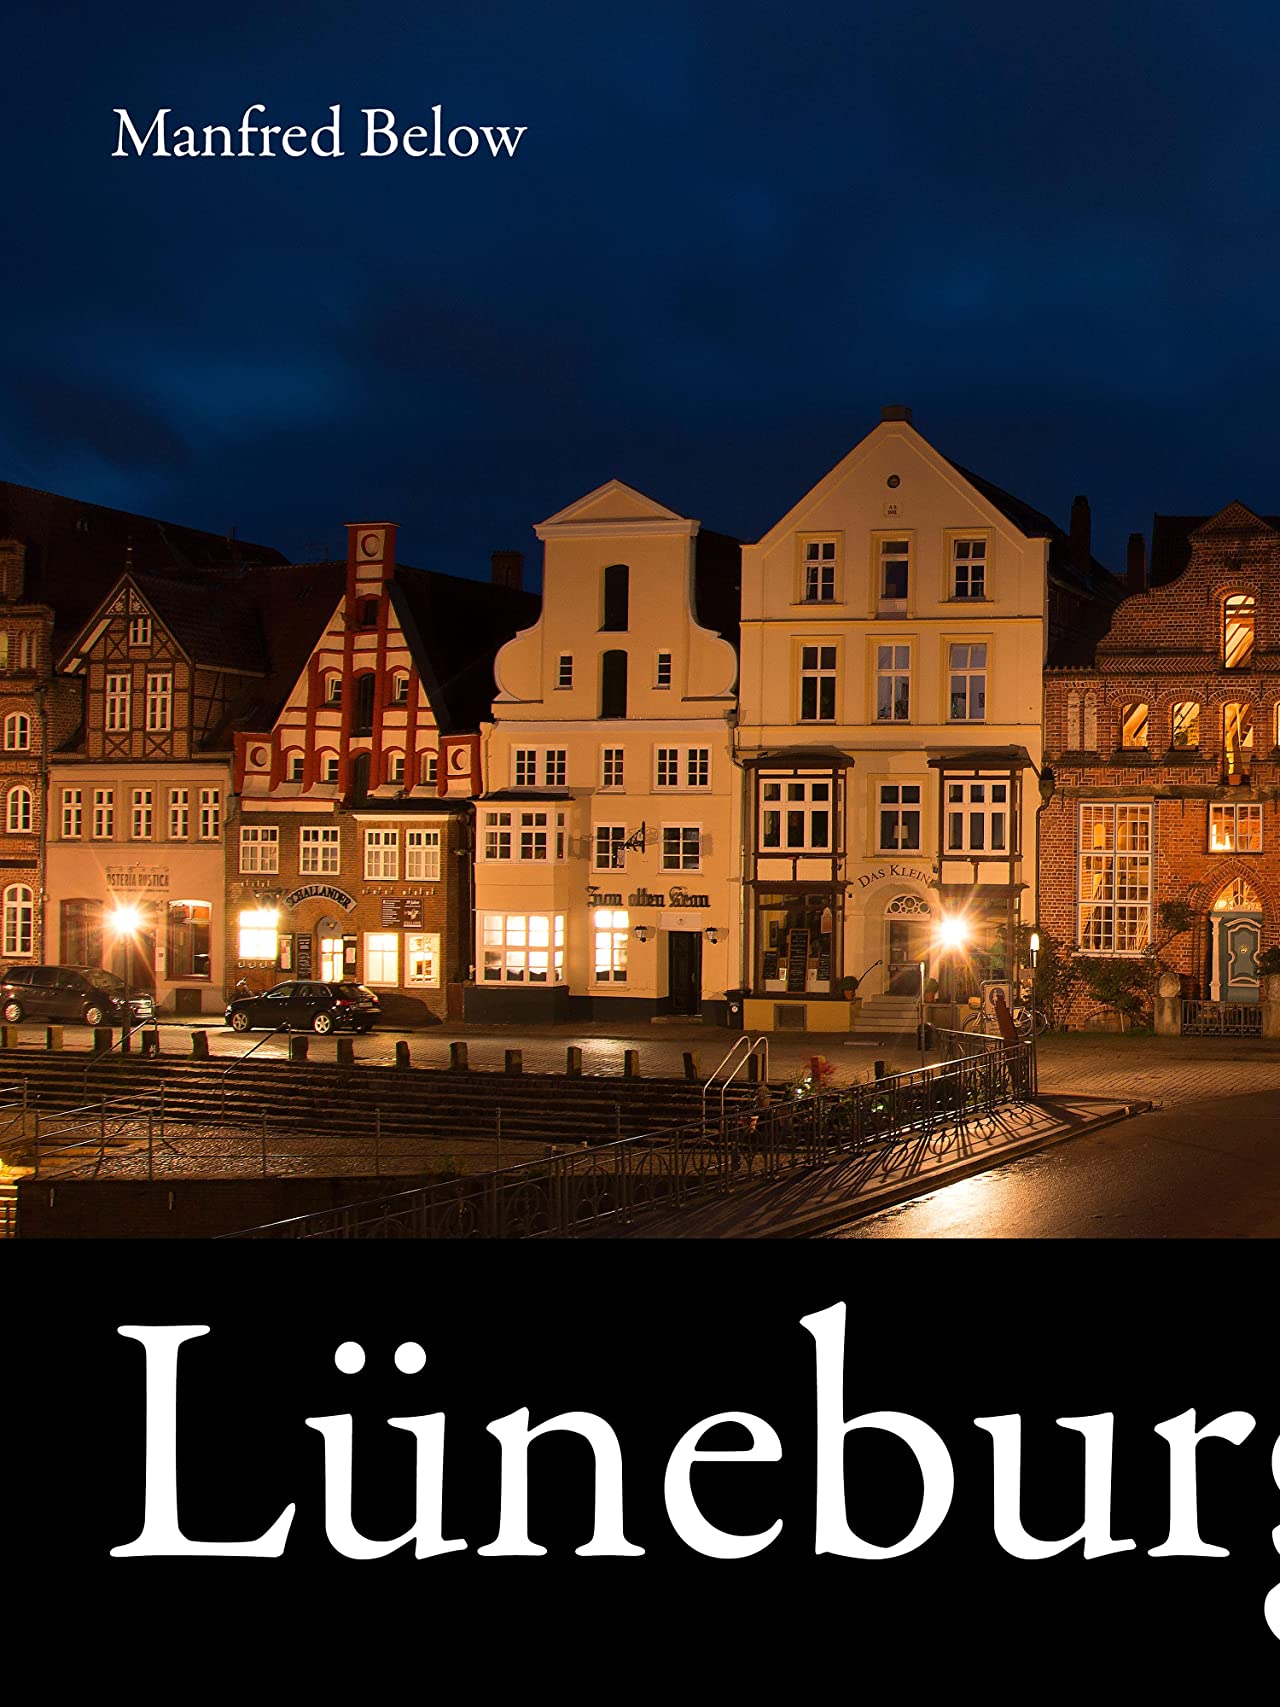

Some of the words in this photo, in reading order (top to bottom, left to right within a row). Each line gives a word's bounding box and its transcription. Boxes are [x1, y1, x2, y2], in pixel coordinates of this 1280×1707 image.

[106, 873, 136, 887] OSTERIA
[138, 873, 169, 887] RUSTICA
[857, 868, 886, 888] DAS
[285, 885, 352, 909] SCHALLANDER
